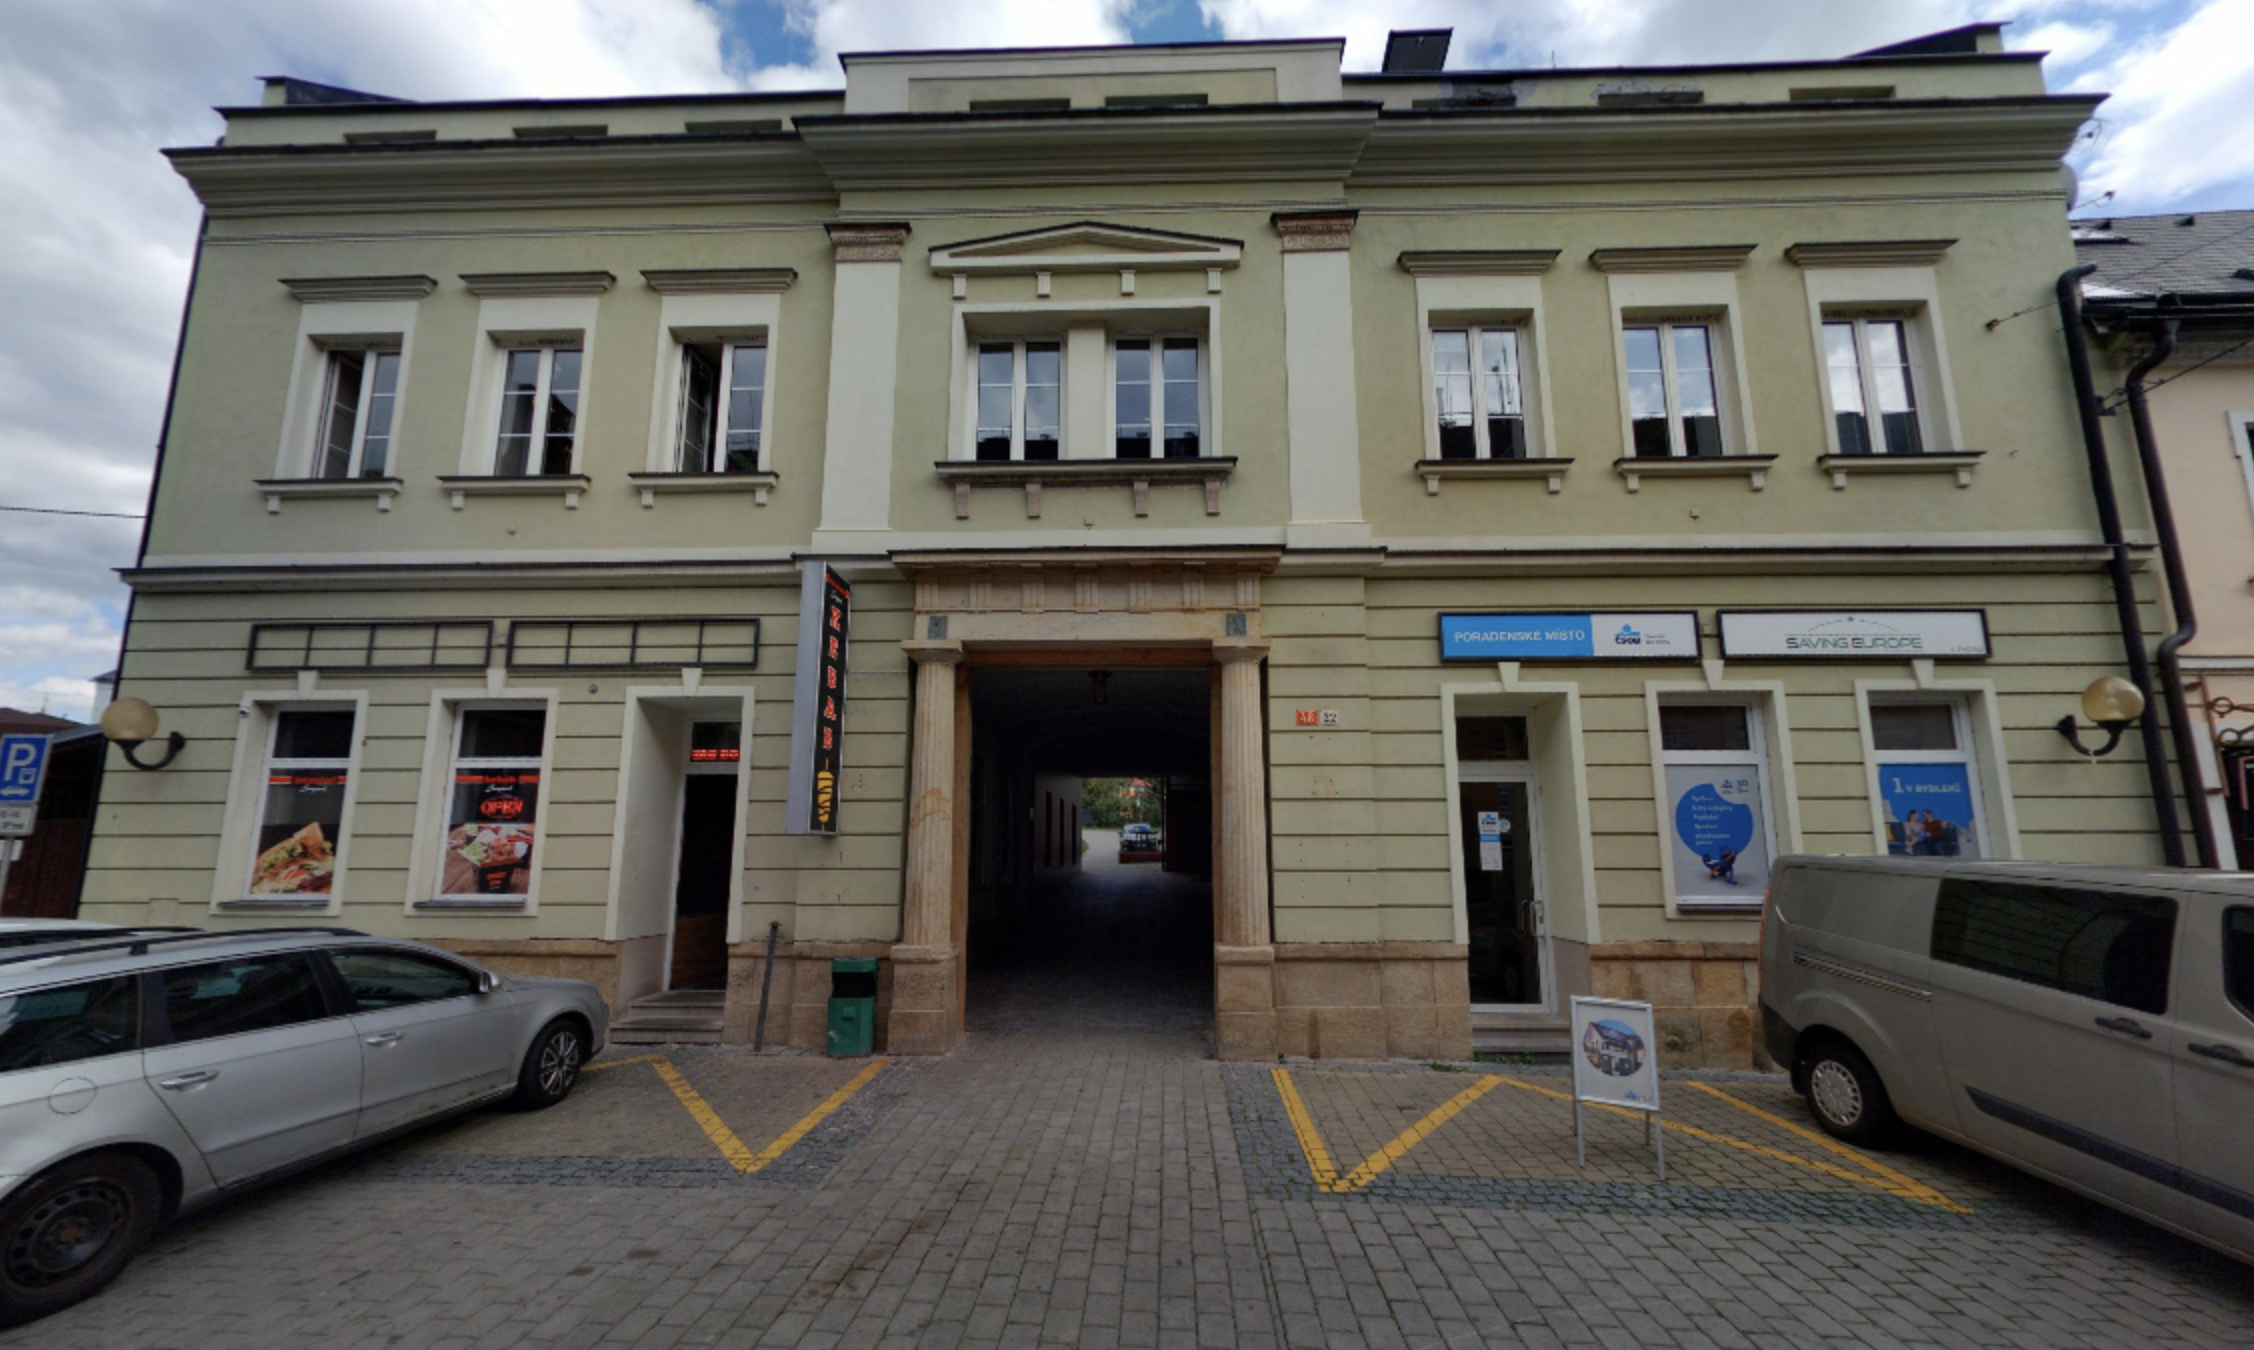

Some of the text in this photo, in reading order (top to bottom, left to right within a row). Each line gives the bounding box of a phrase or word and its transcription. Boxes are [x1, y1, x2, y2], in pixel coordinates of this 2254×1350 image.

[1454, 627, 1585, 643] PORADENSKÉ MÍSTO
[1786, 637, 1923, 649] SAVING EUROPE
[4, 743, 37, 782] P
[1892, 777, 1904, 793] 1
[480, 800, 523, 815] OPEN
